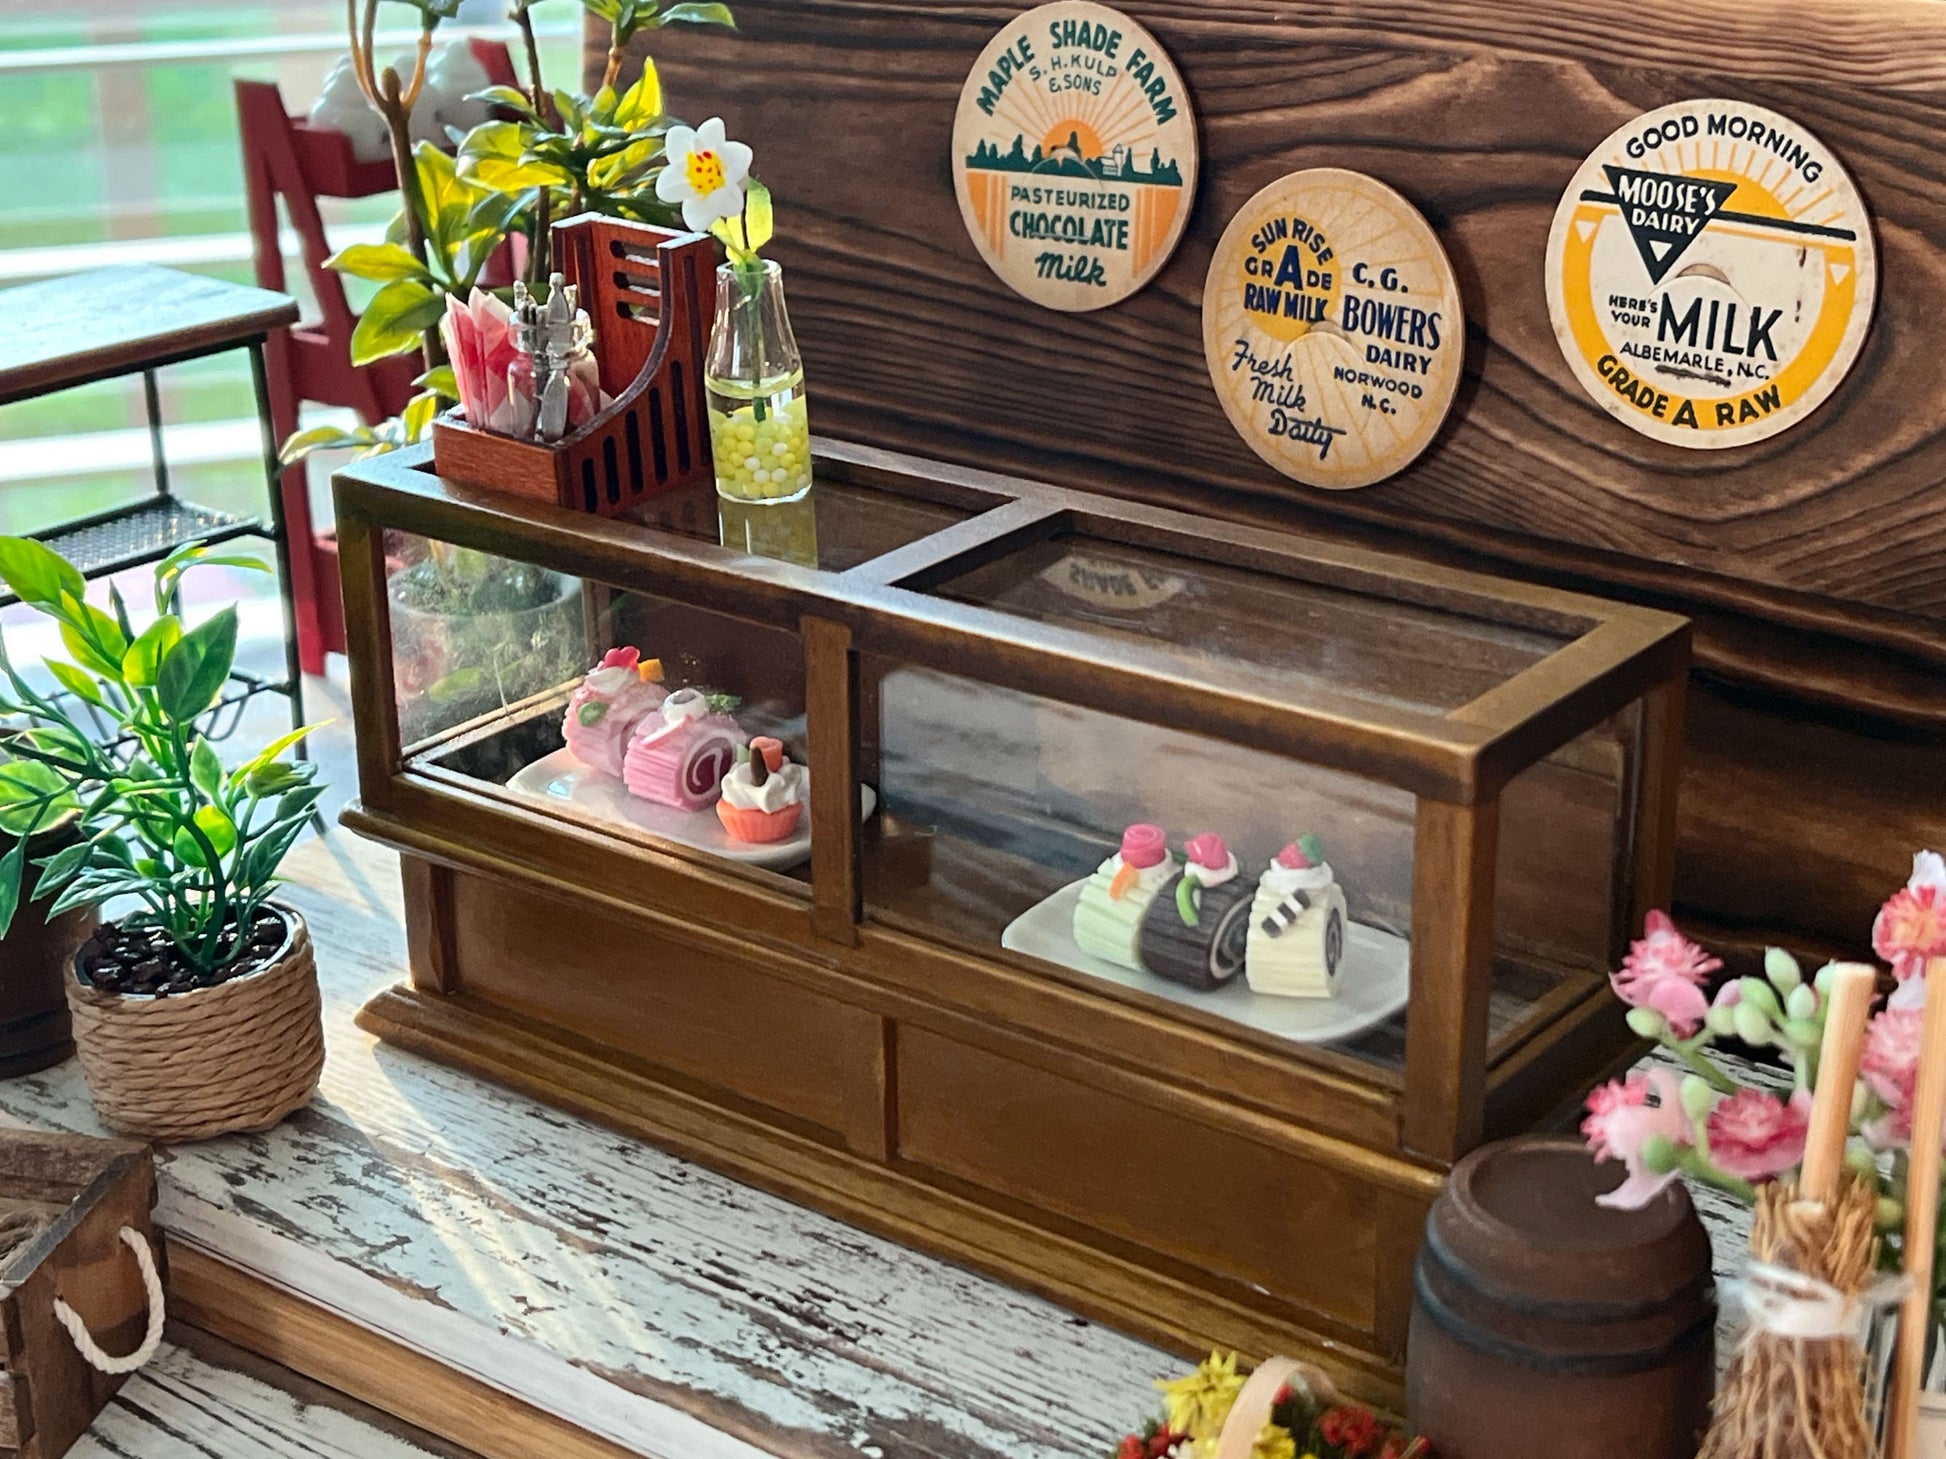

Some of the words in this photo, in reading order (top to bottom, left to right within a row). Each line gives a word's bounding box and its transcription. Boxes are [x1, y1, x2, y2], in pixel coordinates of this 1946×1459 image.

[976, 34, 1036, 116] MAPLE
[1049, 19, 1122, 60] SHADE
[1125, 47, 1178, 126] FARM
[1625, 114, 1699, 159] GOOD
[1707, 113, 1823, 183] MORNING
[1010, 185, 1131, 212] PASTEURIZED
[1618, 174, 1717, 216] MOOSE'S
[1009, 210, 1129, 250] CHOCOLATE
[1631, 207, 1701, 236] DAIRY
[1244, 283, 1282, 315] RAW
[1284, 290, 1328, 323] MILK
[1342, 294, 1442, 350] BOWERS
[1608, 294, 1658, 313] HERE'S
[1611, 310, 1651, 329] YOUR
[1657, 292, 1783, 362] MILK
[1232, 339, 1295, 382] Fresh
[1366, 344, 1432, 375] DAIRY
[1334, 366, 1423, 399] NORWOOD
[1597, 354, 1669, 418] GRADE
[1671, 399, 1699, 429] A
[1715, 384, 1782, 426] RAW
